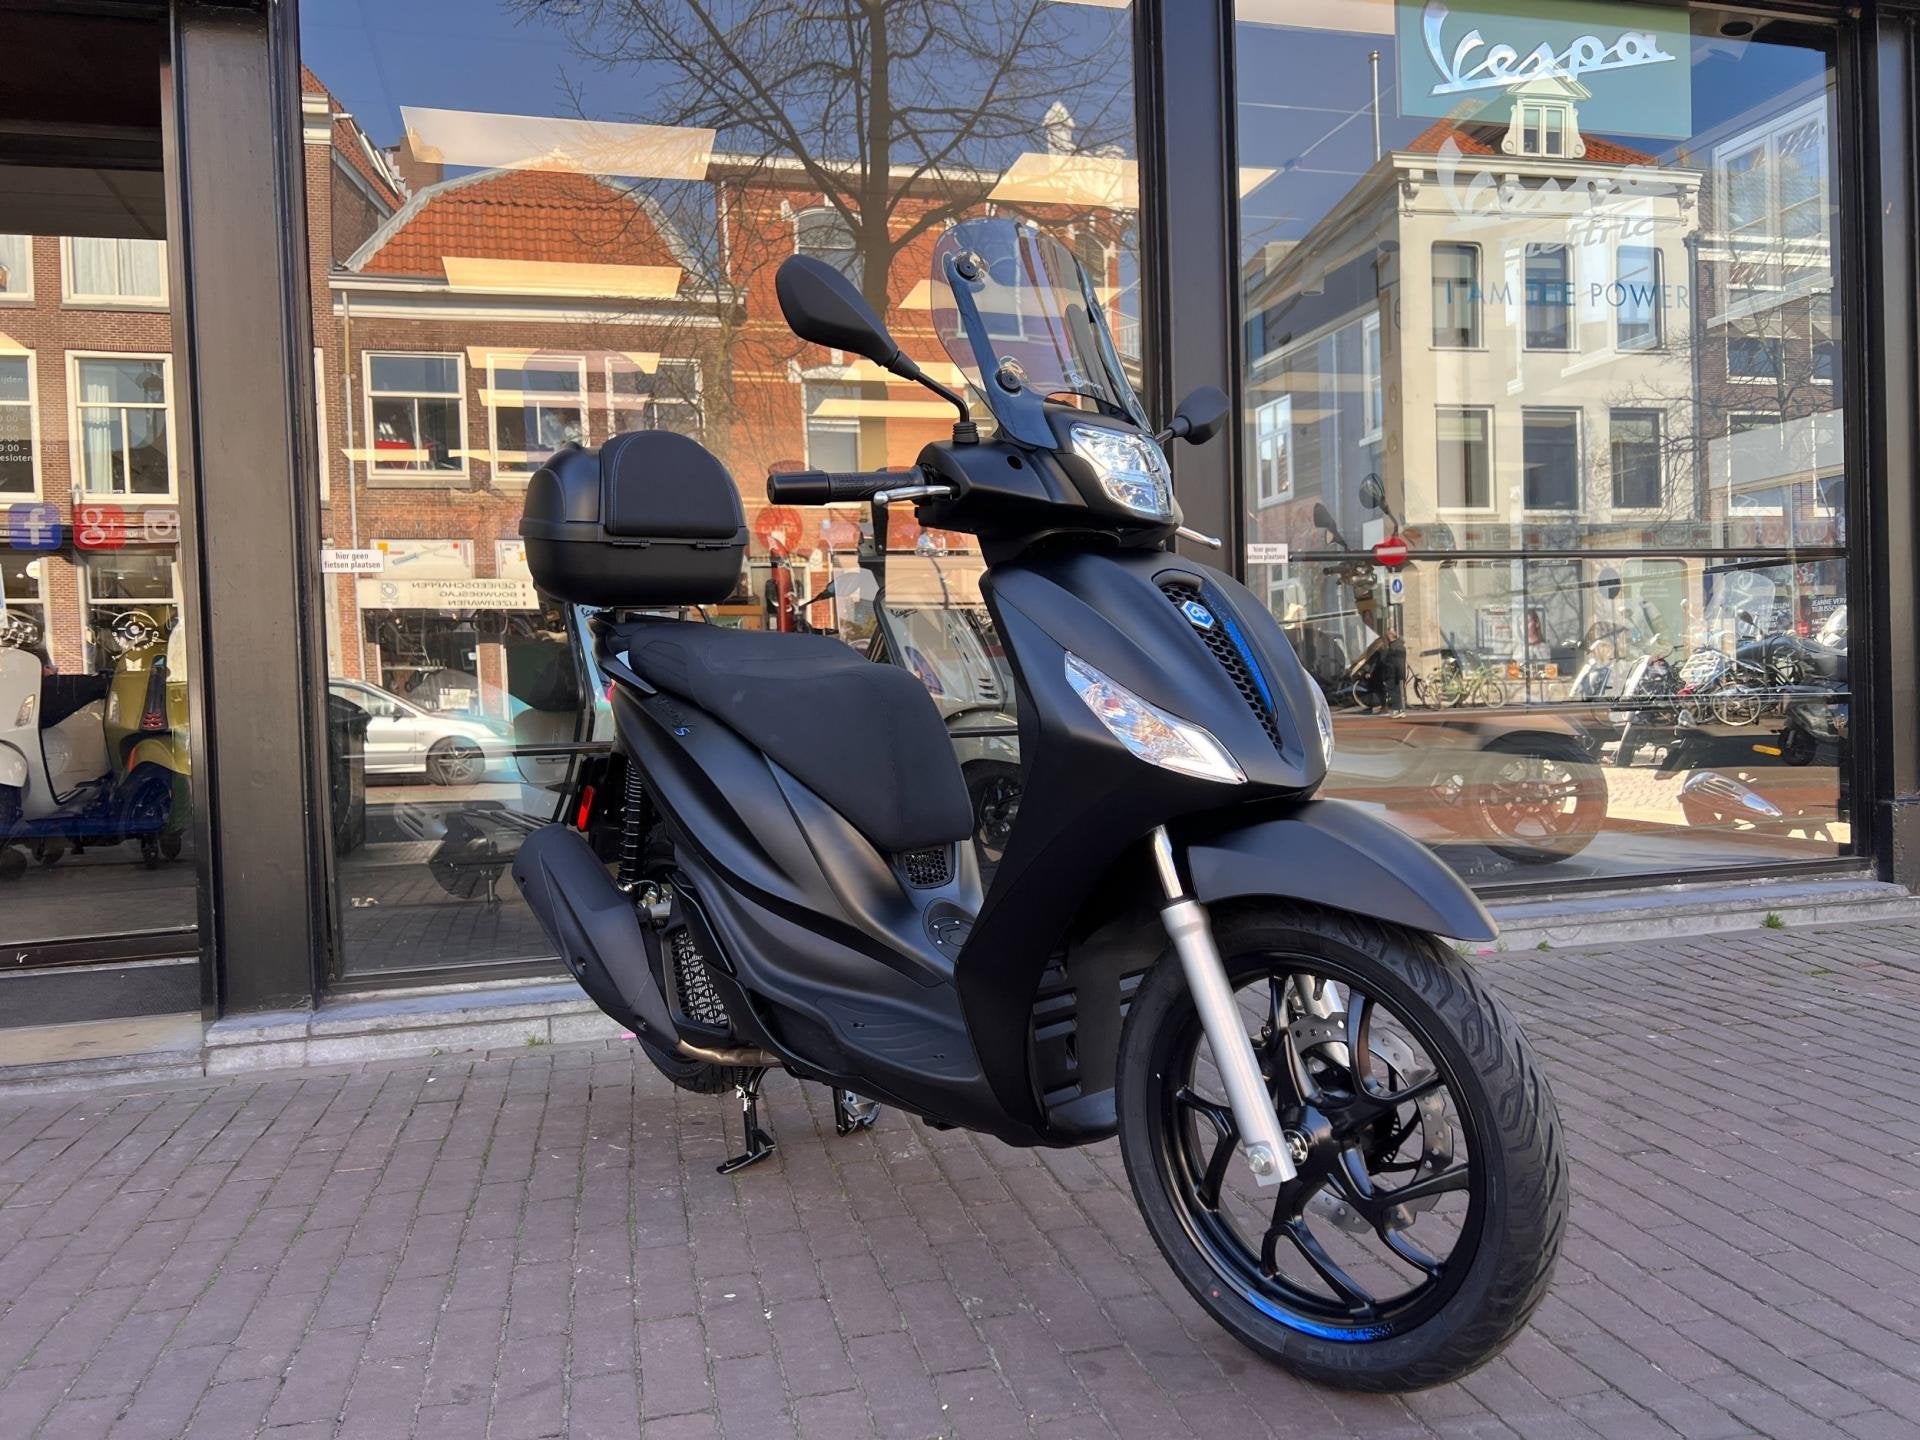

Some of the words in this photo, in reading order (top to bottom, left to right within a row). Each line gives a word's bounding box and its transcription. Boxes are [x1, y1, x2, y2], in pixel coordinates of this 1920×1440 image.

[1424, 0, 1676, 95] Vespa
[1437, 136, 1680, 234] Vespa
[1446, 279, 1452, 305] I
[1467, 280, 1512, 305] AM
[1526, 281, 1576, 307] THE
[1591, 281, 1690, 308] POWER
[324, 561, 349, 569] fietsen
[350, 561, 381, 571] plaatsen
[335, 551, 349, 560] hier
[352, 553, 369, 562] geen
